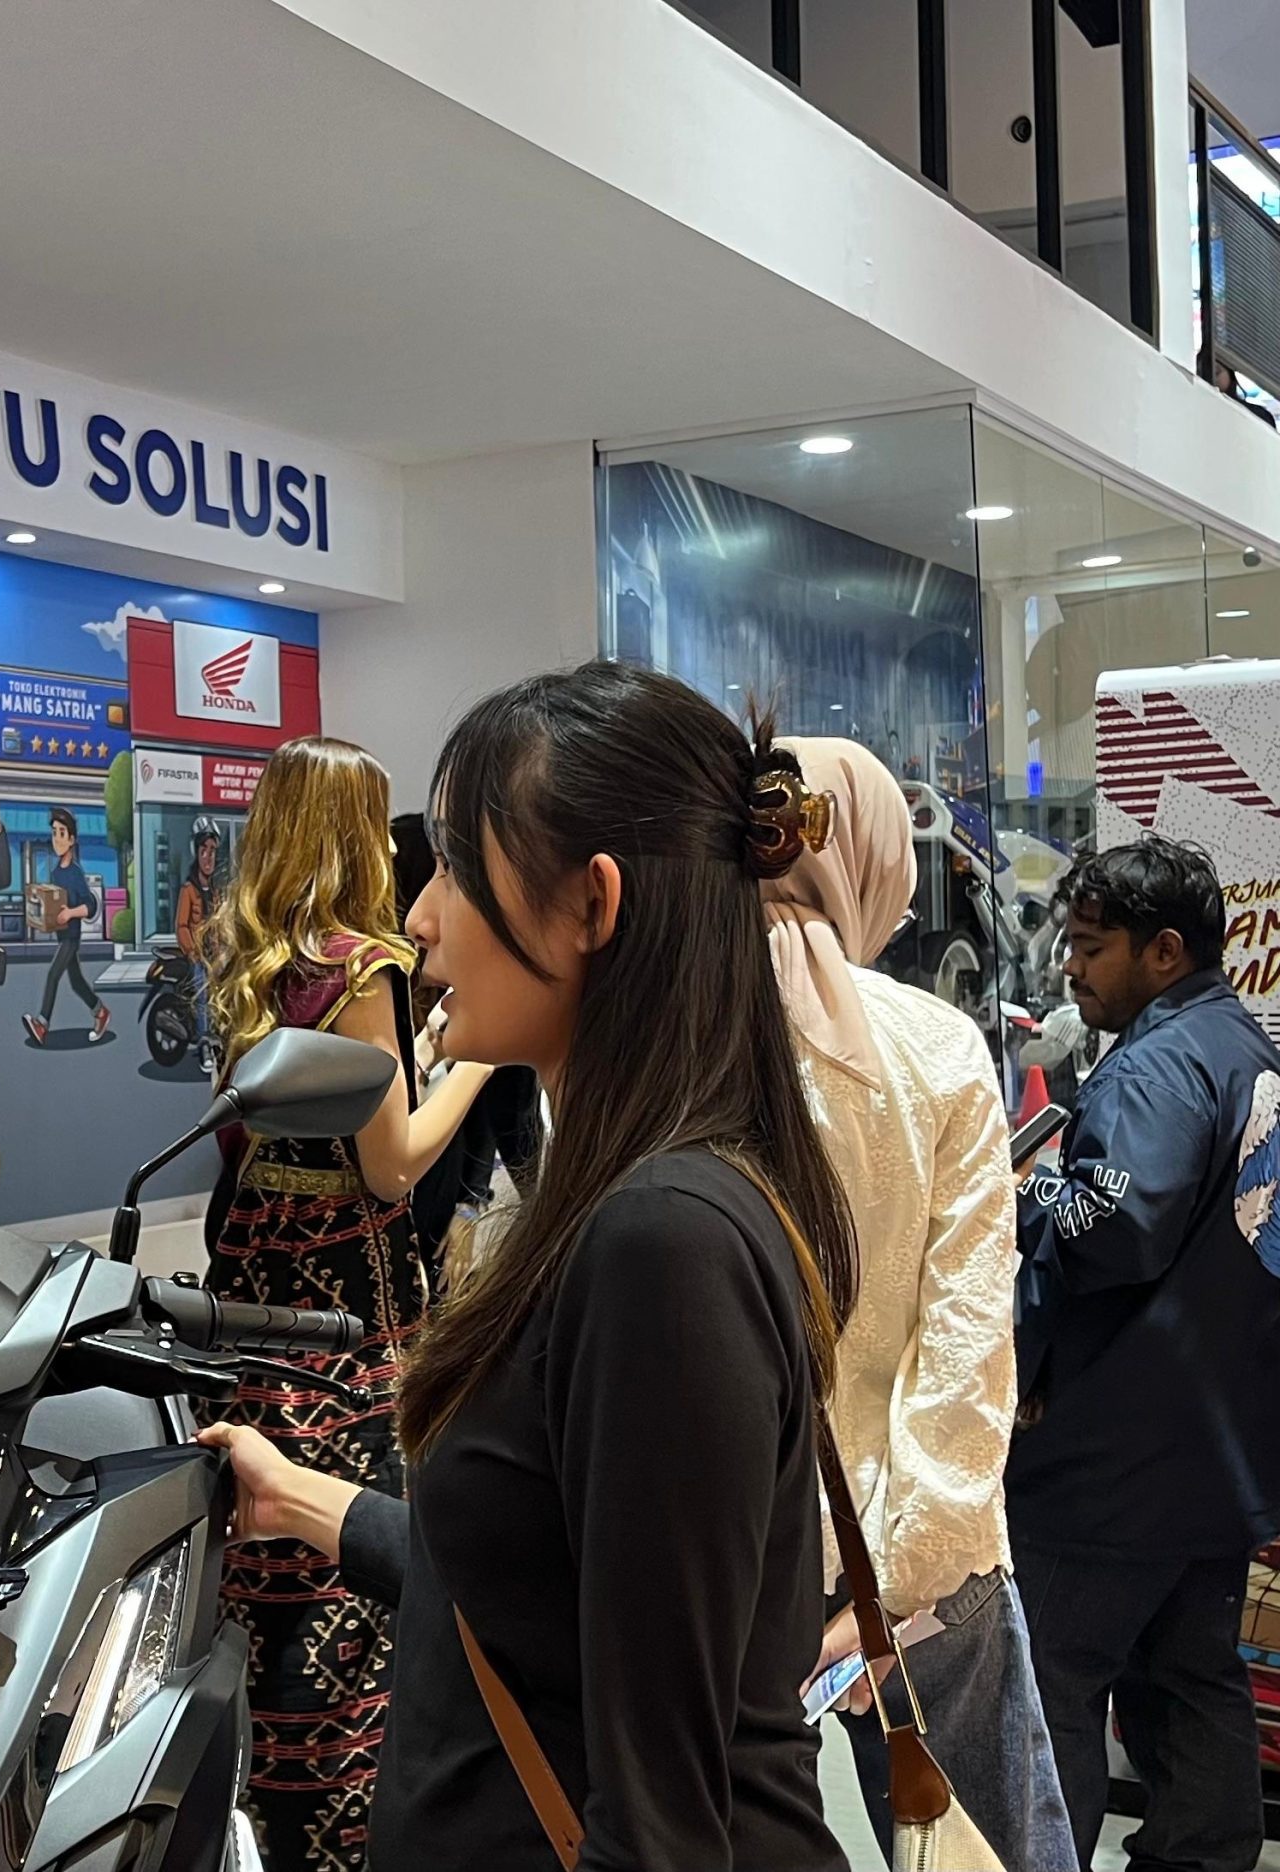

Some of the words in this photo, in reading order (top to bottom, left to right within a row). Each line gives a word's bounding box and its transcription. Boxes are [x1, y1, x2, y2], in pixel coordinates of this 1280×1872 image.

[86, 413, 329, 553] SOLUSI
[8, 680, 32, 695] TOKO
[33, 683, 88, 701] ELEKTRONIK
[202, 694, 257, 713] HONDA
[157, 768, 199, 781] FIFASTRA
